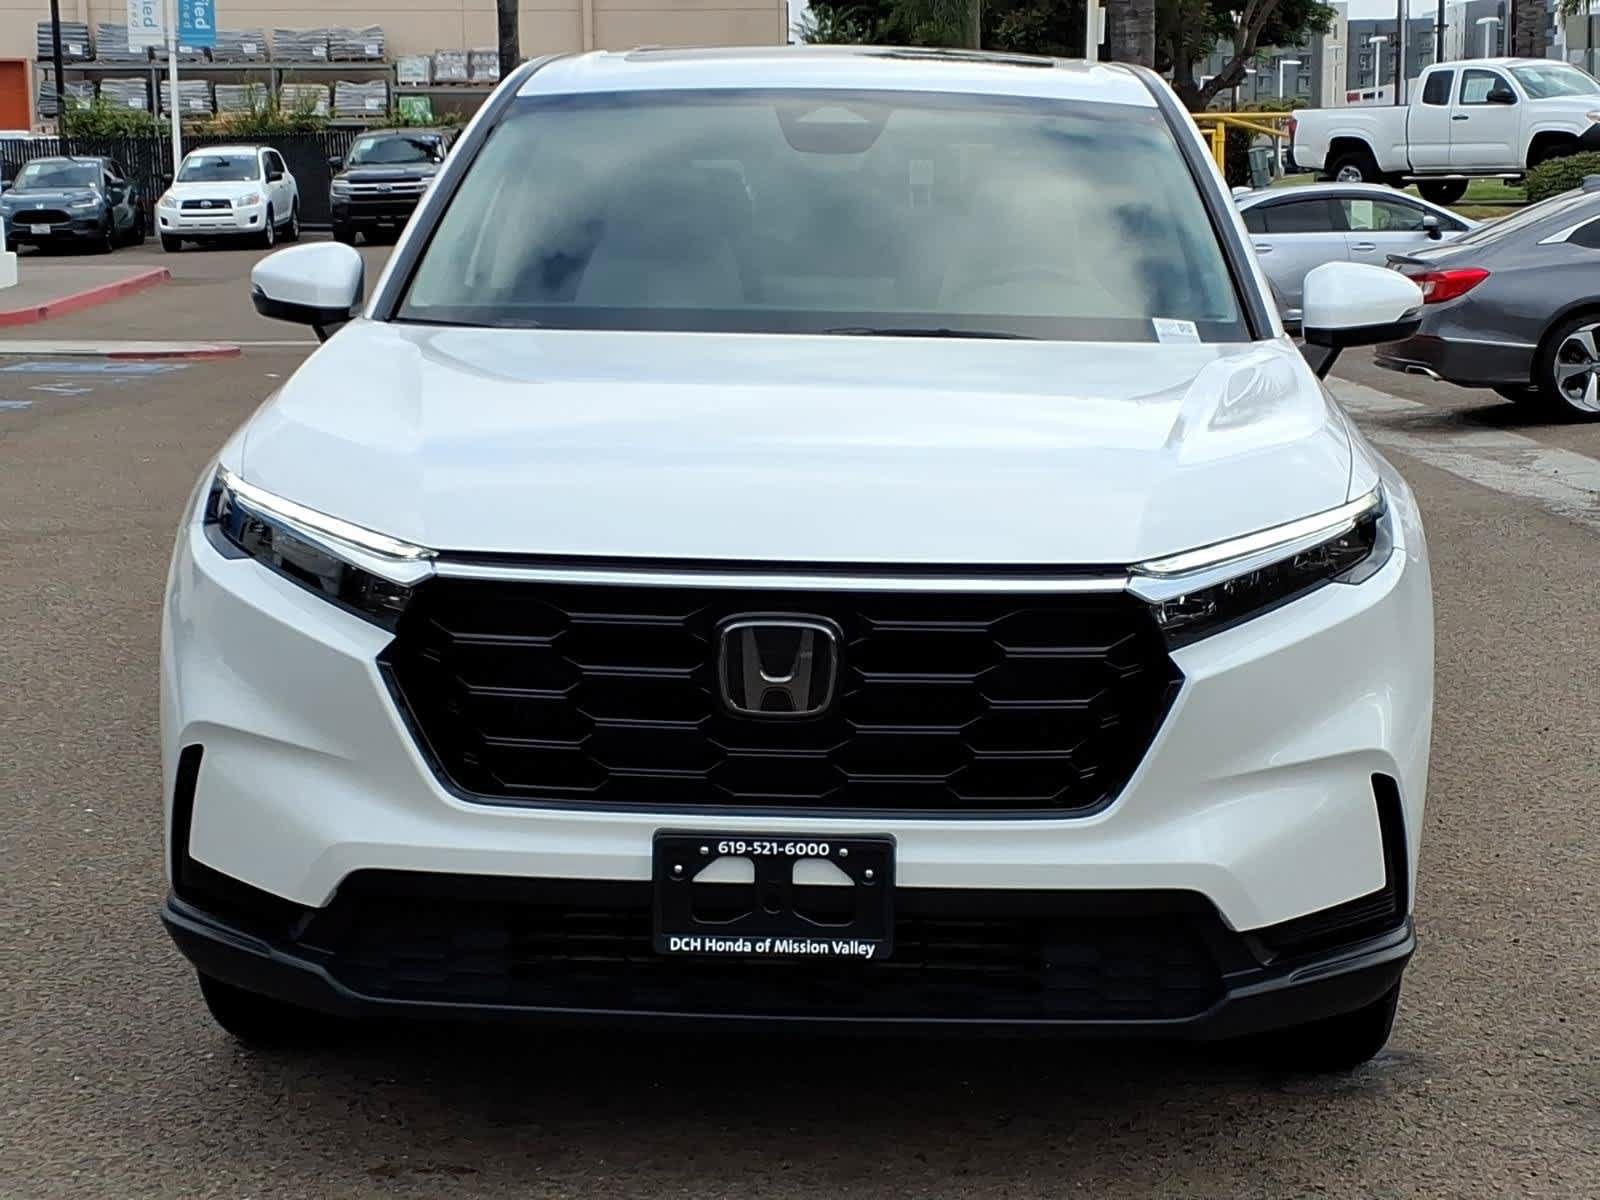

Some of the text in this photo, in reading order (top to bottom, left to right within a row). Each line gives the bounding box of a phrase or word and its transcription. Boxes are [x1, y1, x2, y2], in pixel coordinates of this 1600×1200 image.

[194, 0, 211, 29] ied
[717, 841, 830, 856] 619-521-6000
[670, 937, 876, 959] DCH Honda of Mission Valley
